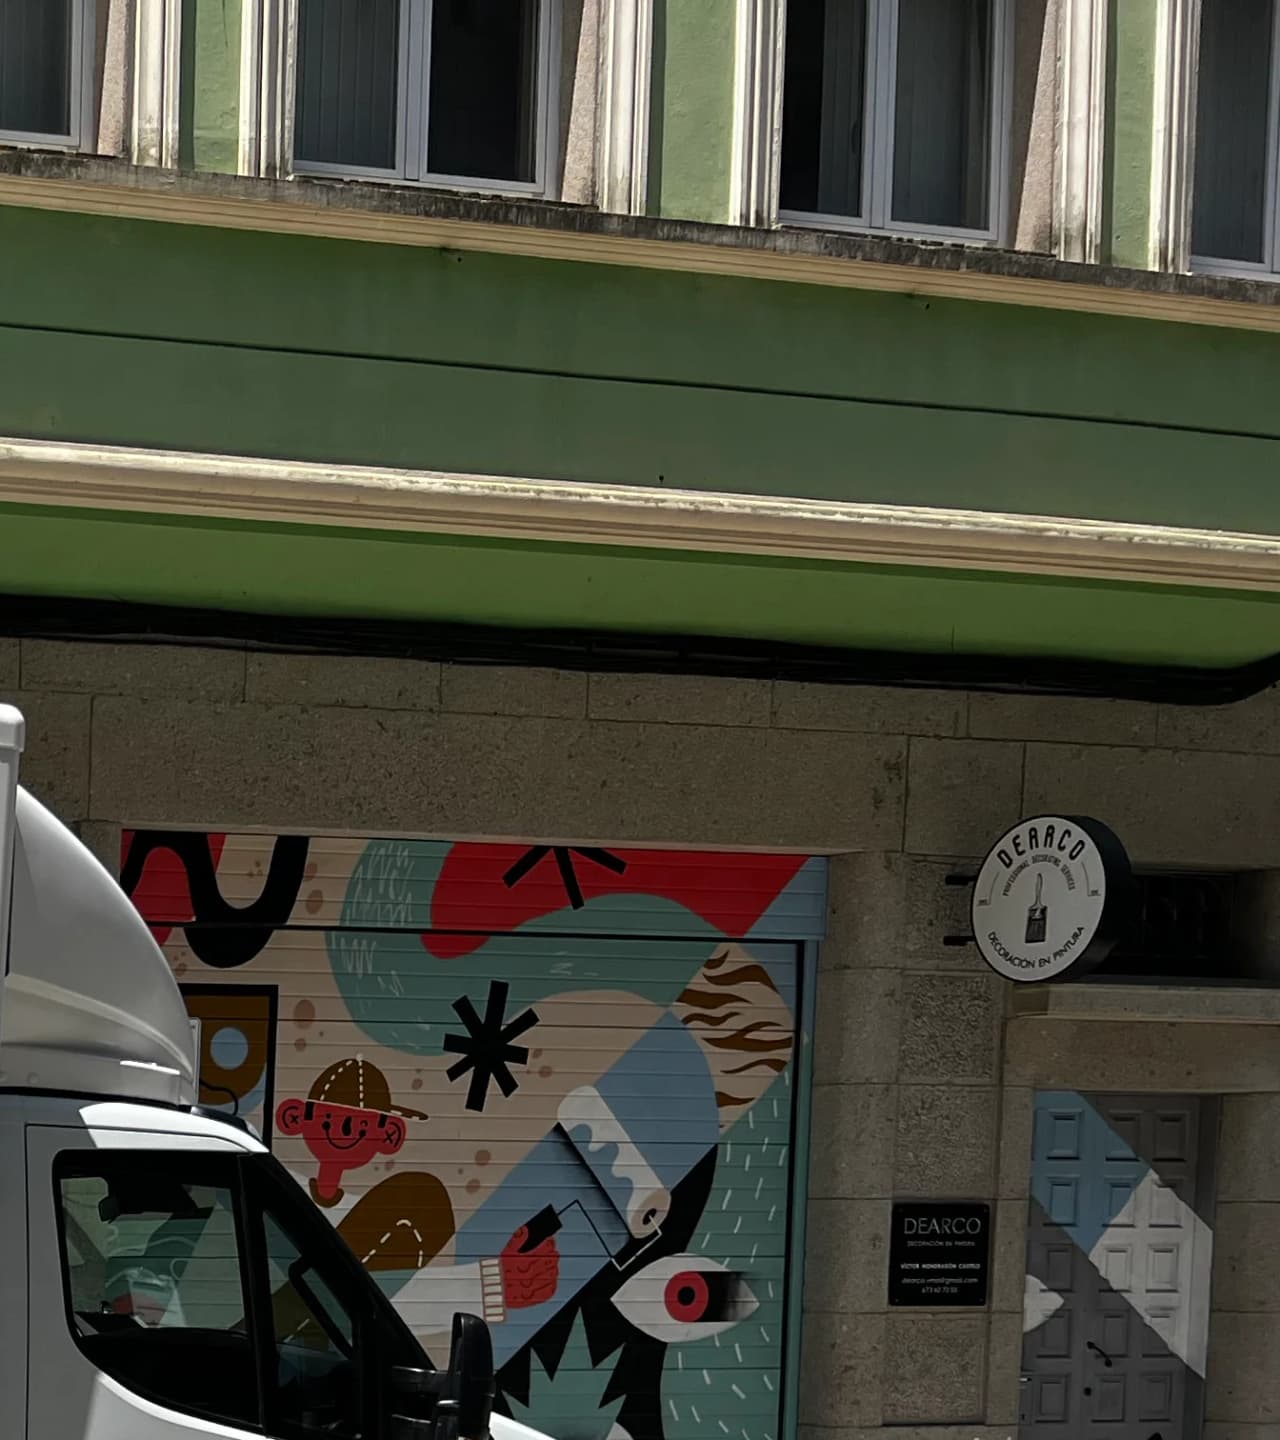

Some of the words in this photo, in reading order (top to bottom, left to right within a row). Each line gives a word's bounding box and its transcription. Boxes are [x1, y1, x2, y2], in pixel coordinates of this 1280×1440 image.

[996, 824, 1086, 869] DEARCO
[987, 931, 1036, 969] DECORACIÓN
[1038, 956, 1052, 968] EN
[1053, 926, 1085, 960] PINTURA
[903, 1217, 982, 1235] DEARCO
